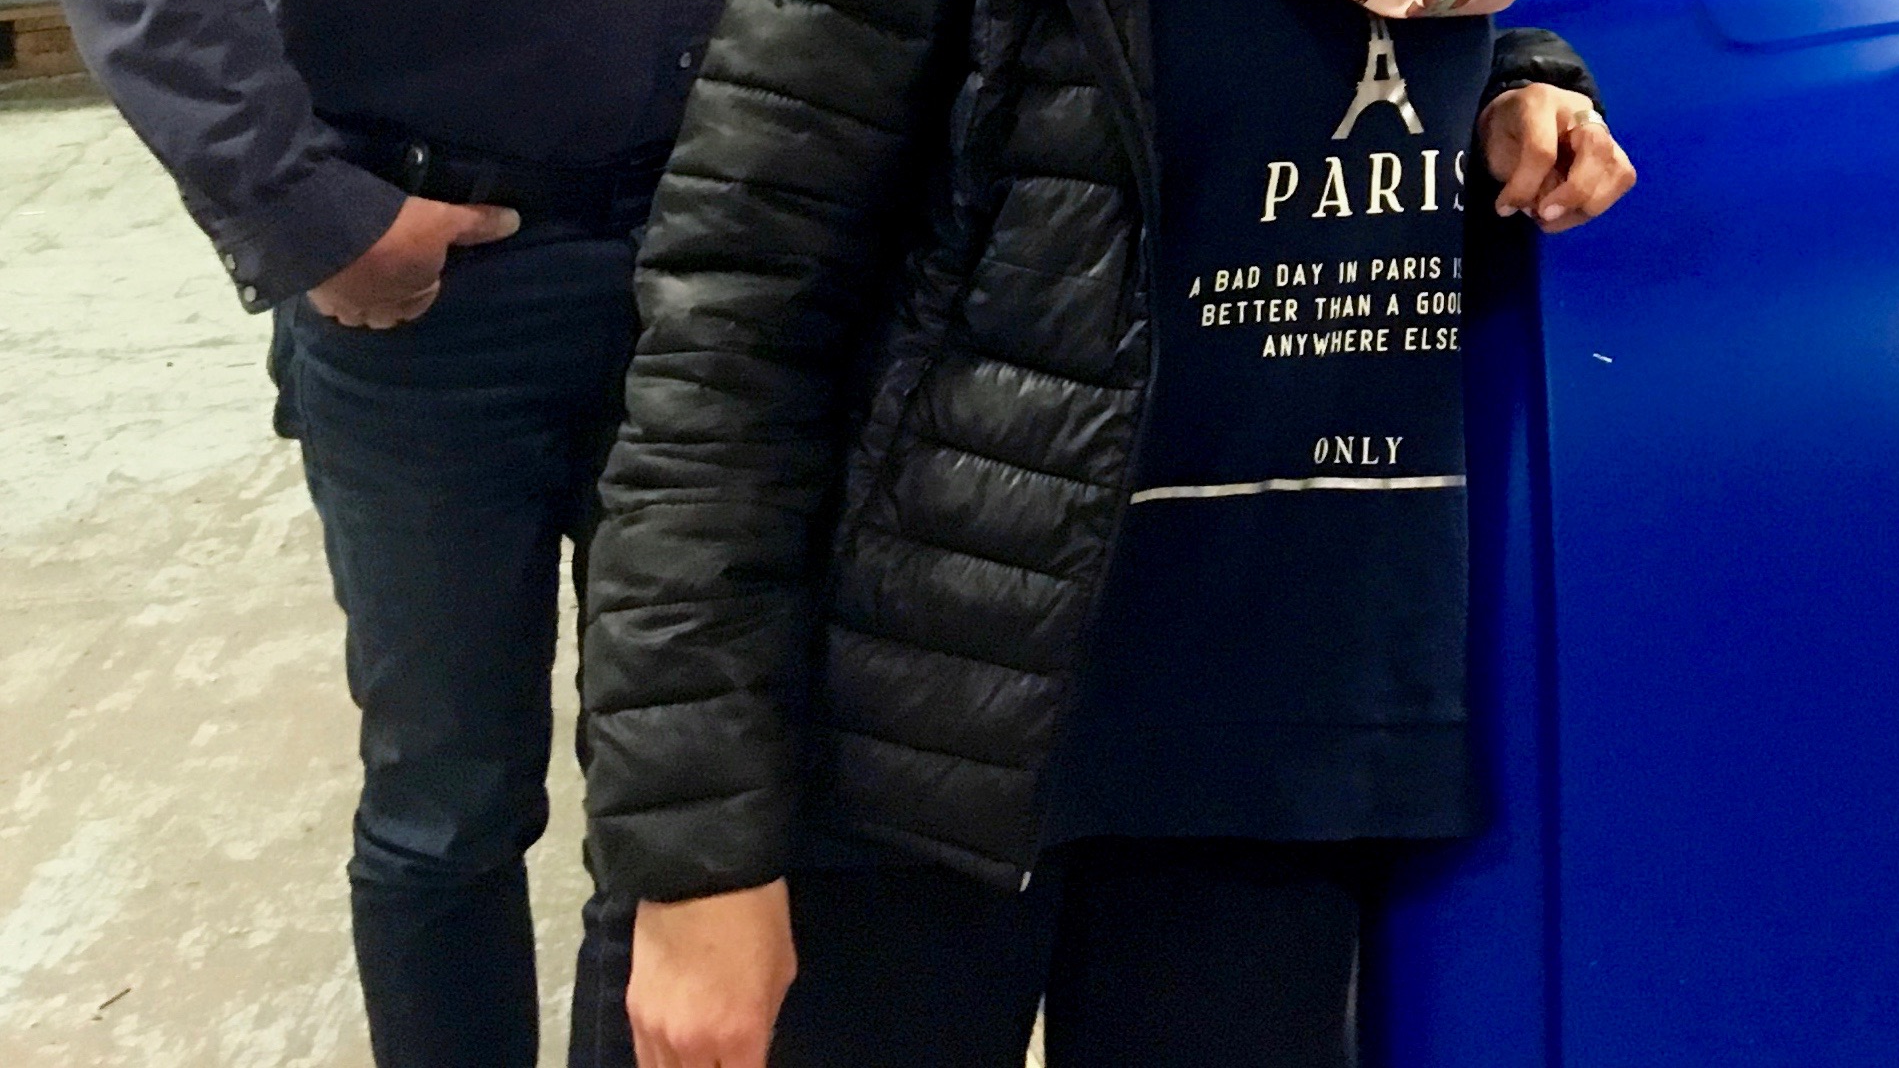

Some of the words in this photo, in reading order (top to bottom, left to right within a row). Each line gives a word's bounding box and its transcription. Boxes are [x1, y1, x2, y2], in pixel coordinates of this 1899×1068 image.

[1188, 276, 1201, 299] A
[1214, 266, 1261, 292] BAD
[1276, 263, 1323, 287] DAY
[1338, 260, 1358, 284] IN
[1371, 256, 1442, 281] PARIS
[1201, 298, 1299, 327] BETTER
[1315, 294, 1371, 320] THAN
[1386, 293, 1400, 316] A
[1262, 328, 1389, 358] ANYWHERE
[1312, 435, 1403, 465] ONLY
